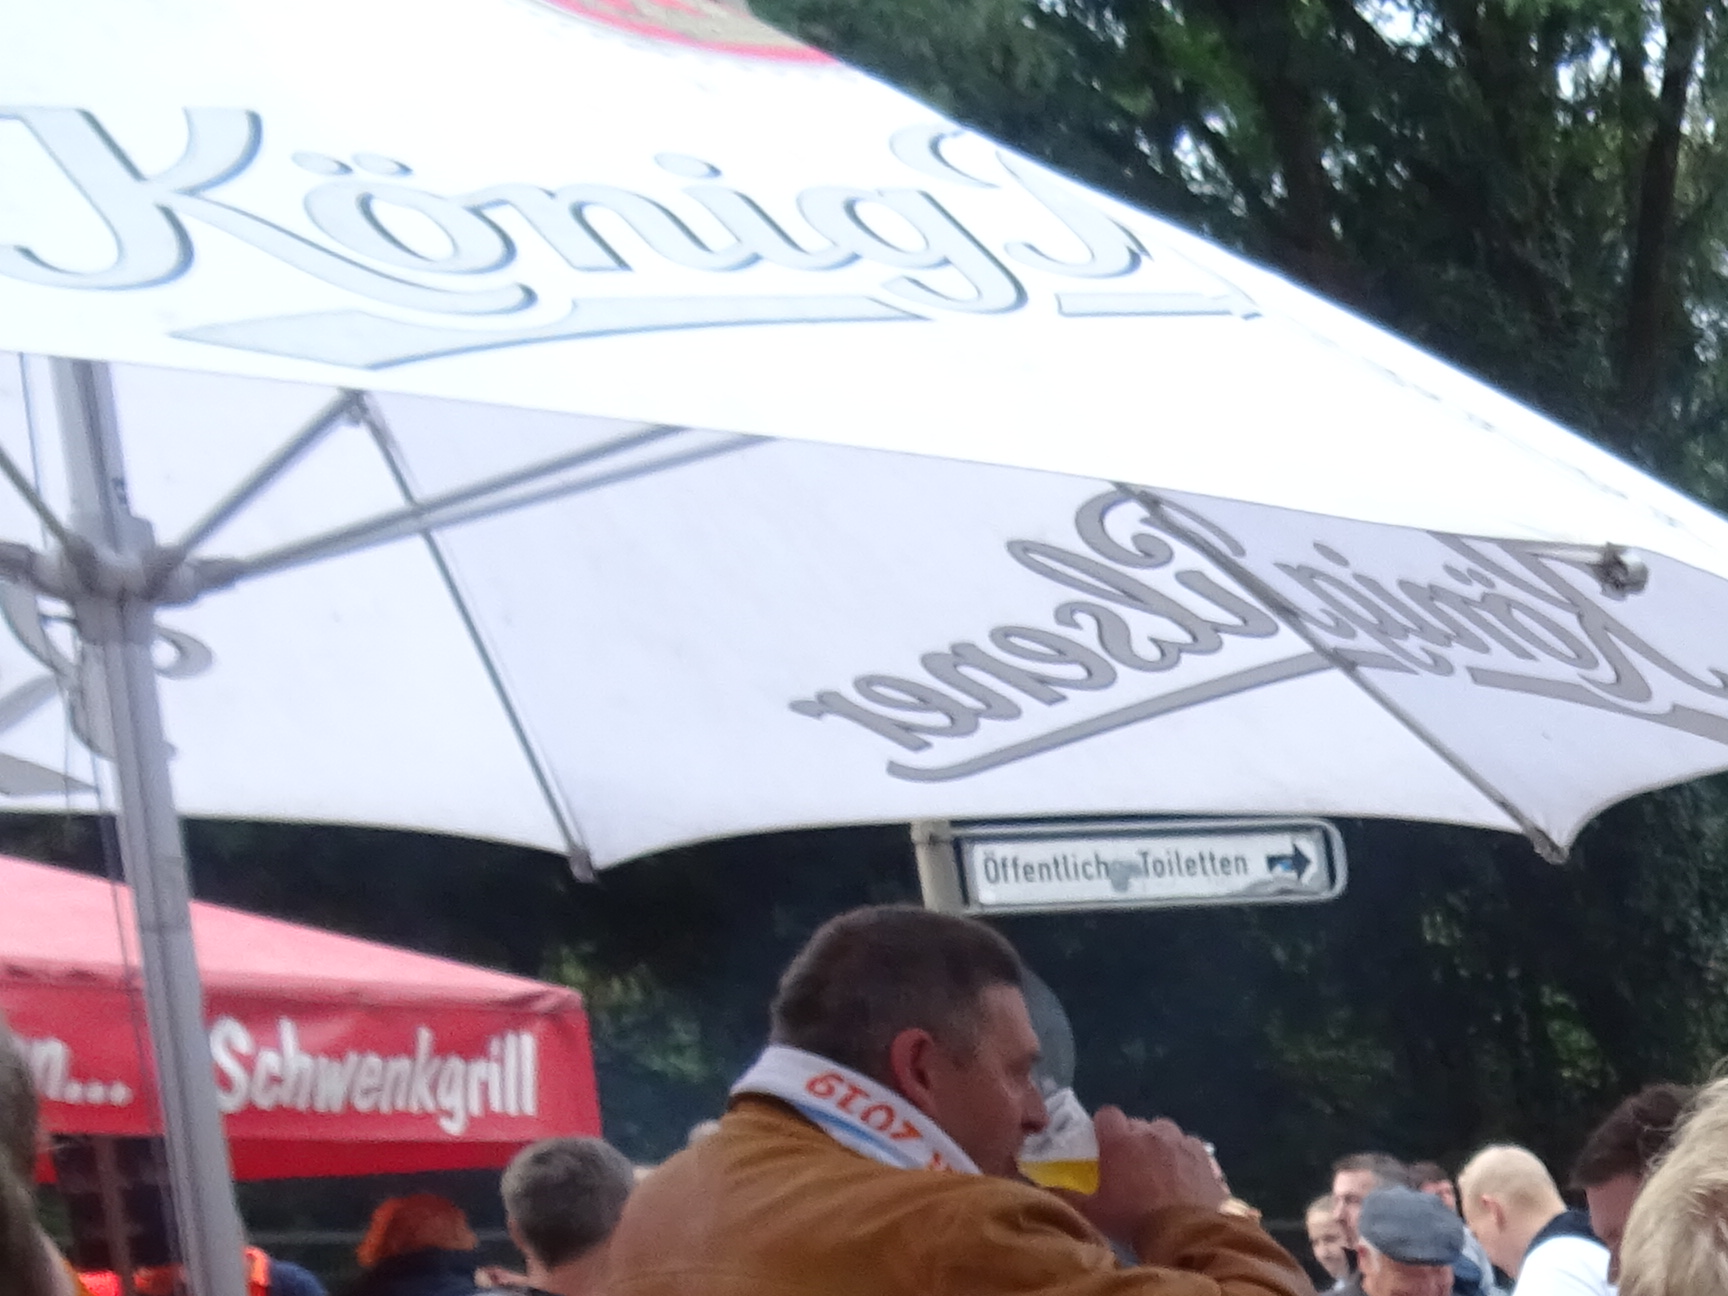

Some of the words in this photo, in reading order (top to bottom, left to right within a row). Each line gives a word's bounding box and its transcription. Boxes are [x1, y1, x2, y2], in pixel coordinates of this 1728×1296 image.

[983, 850, 1118, 885] Öffentlich
[1138, 848, 1249, 878] Toiletten
[208, 1016, 538, 1135] Schwenkgrill
[806, 1071, 922, 1140] 2019
